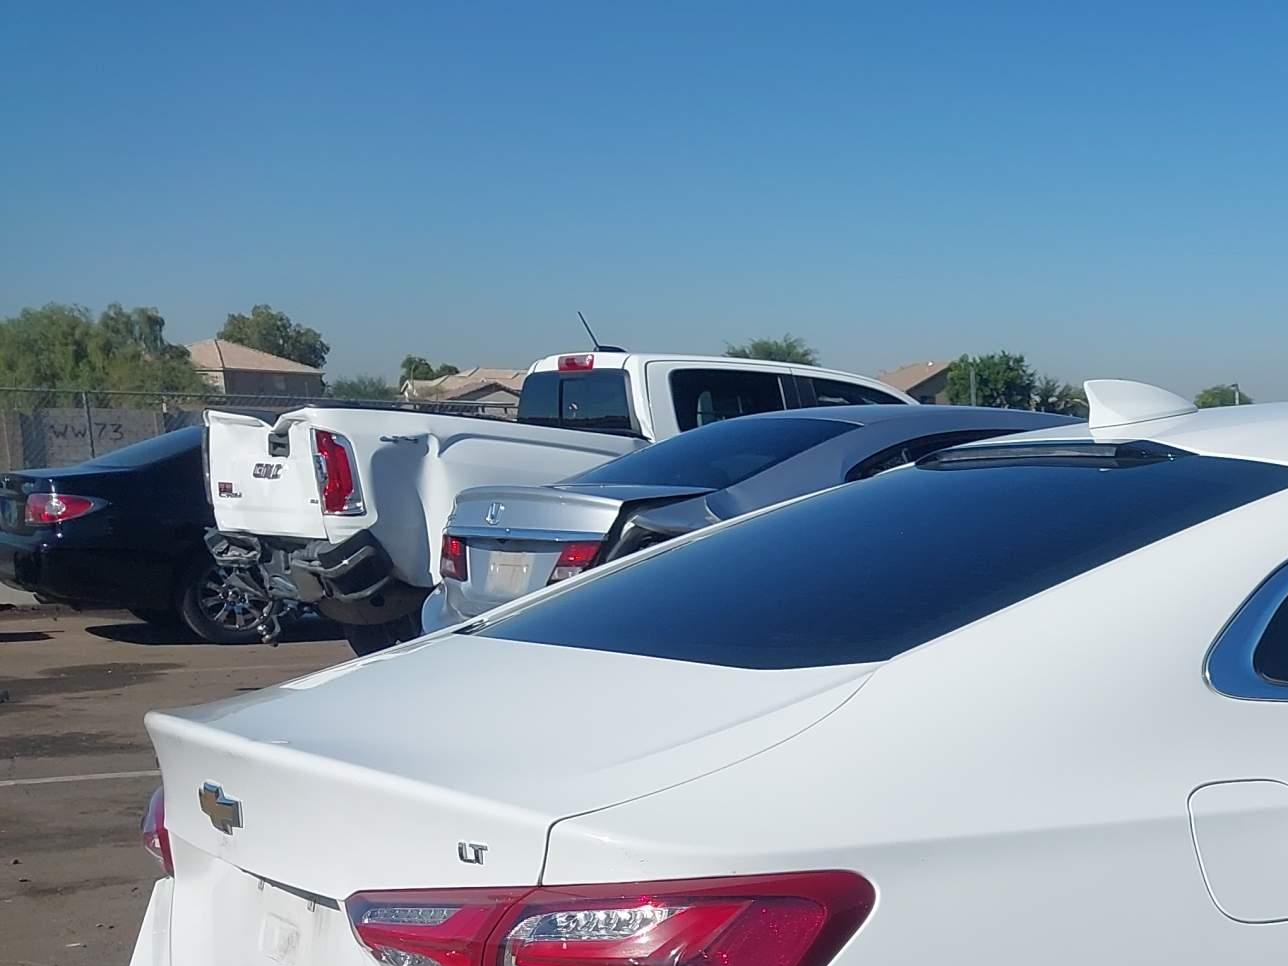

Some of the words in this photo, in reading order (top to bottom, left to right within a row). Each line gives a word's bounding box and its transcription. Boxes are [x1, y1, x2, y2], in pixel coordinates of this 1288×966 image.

[49, 423, 88, 439] WW
[94, 422, 125, 441] 73
[457, 841, 489, 866] LT
